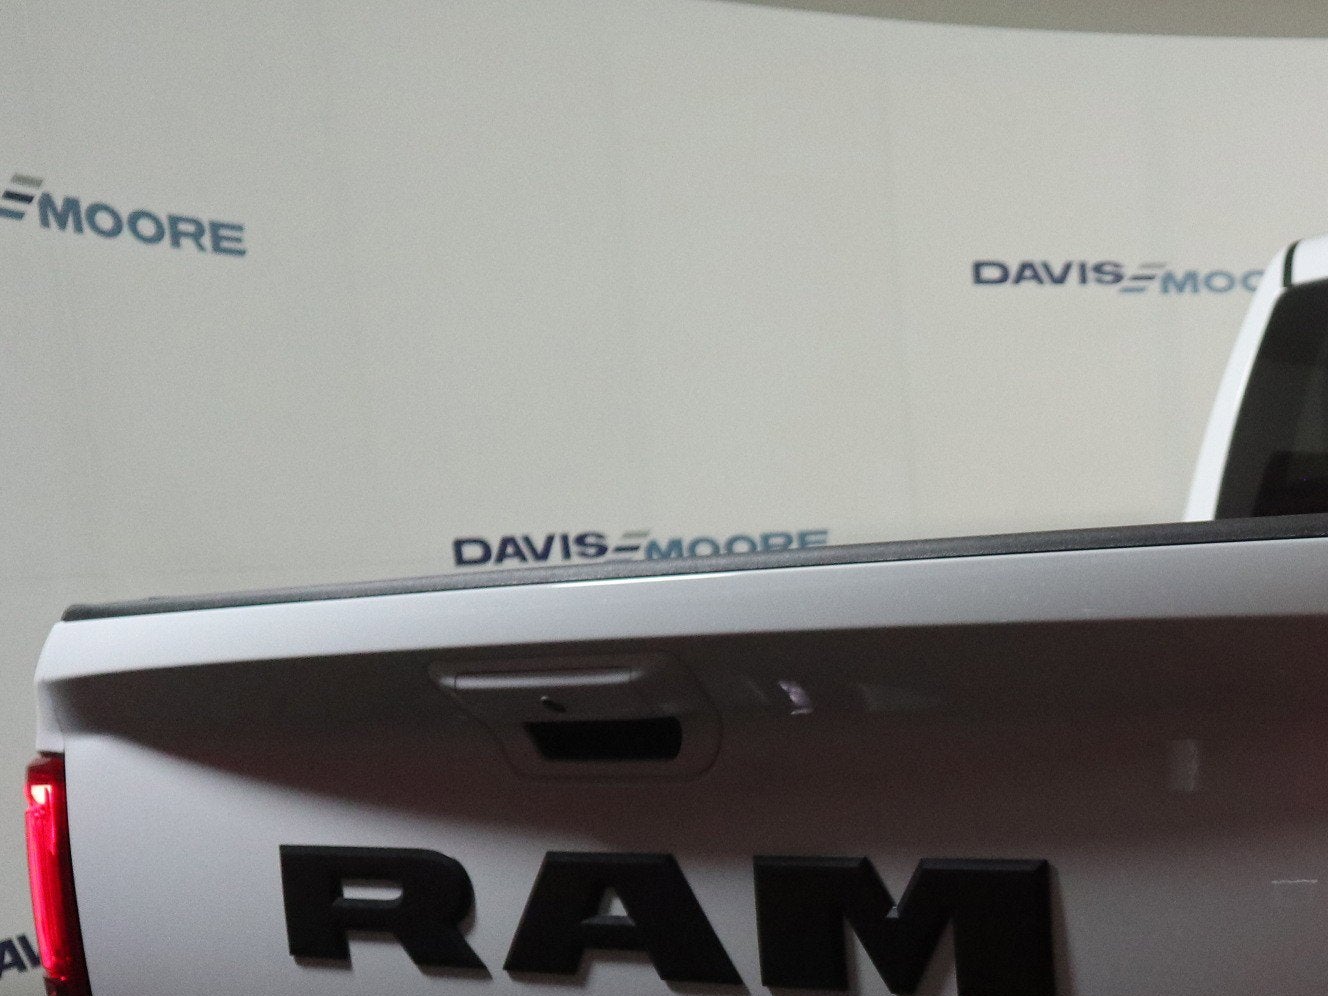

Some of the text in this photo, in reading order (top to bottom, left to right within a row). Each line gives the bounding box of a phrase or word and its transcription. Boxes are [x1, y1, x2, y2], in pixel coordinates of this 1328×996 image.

[38, 191, 247, 256] MOORE
[972, 260, 1265, 294] DAVIS MOO
[452, 531, 608, 567] DAVIS
